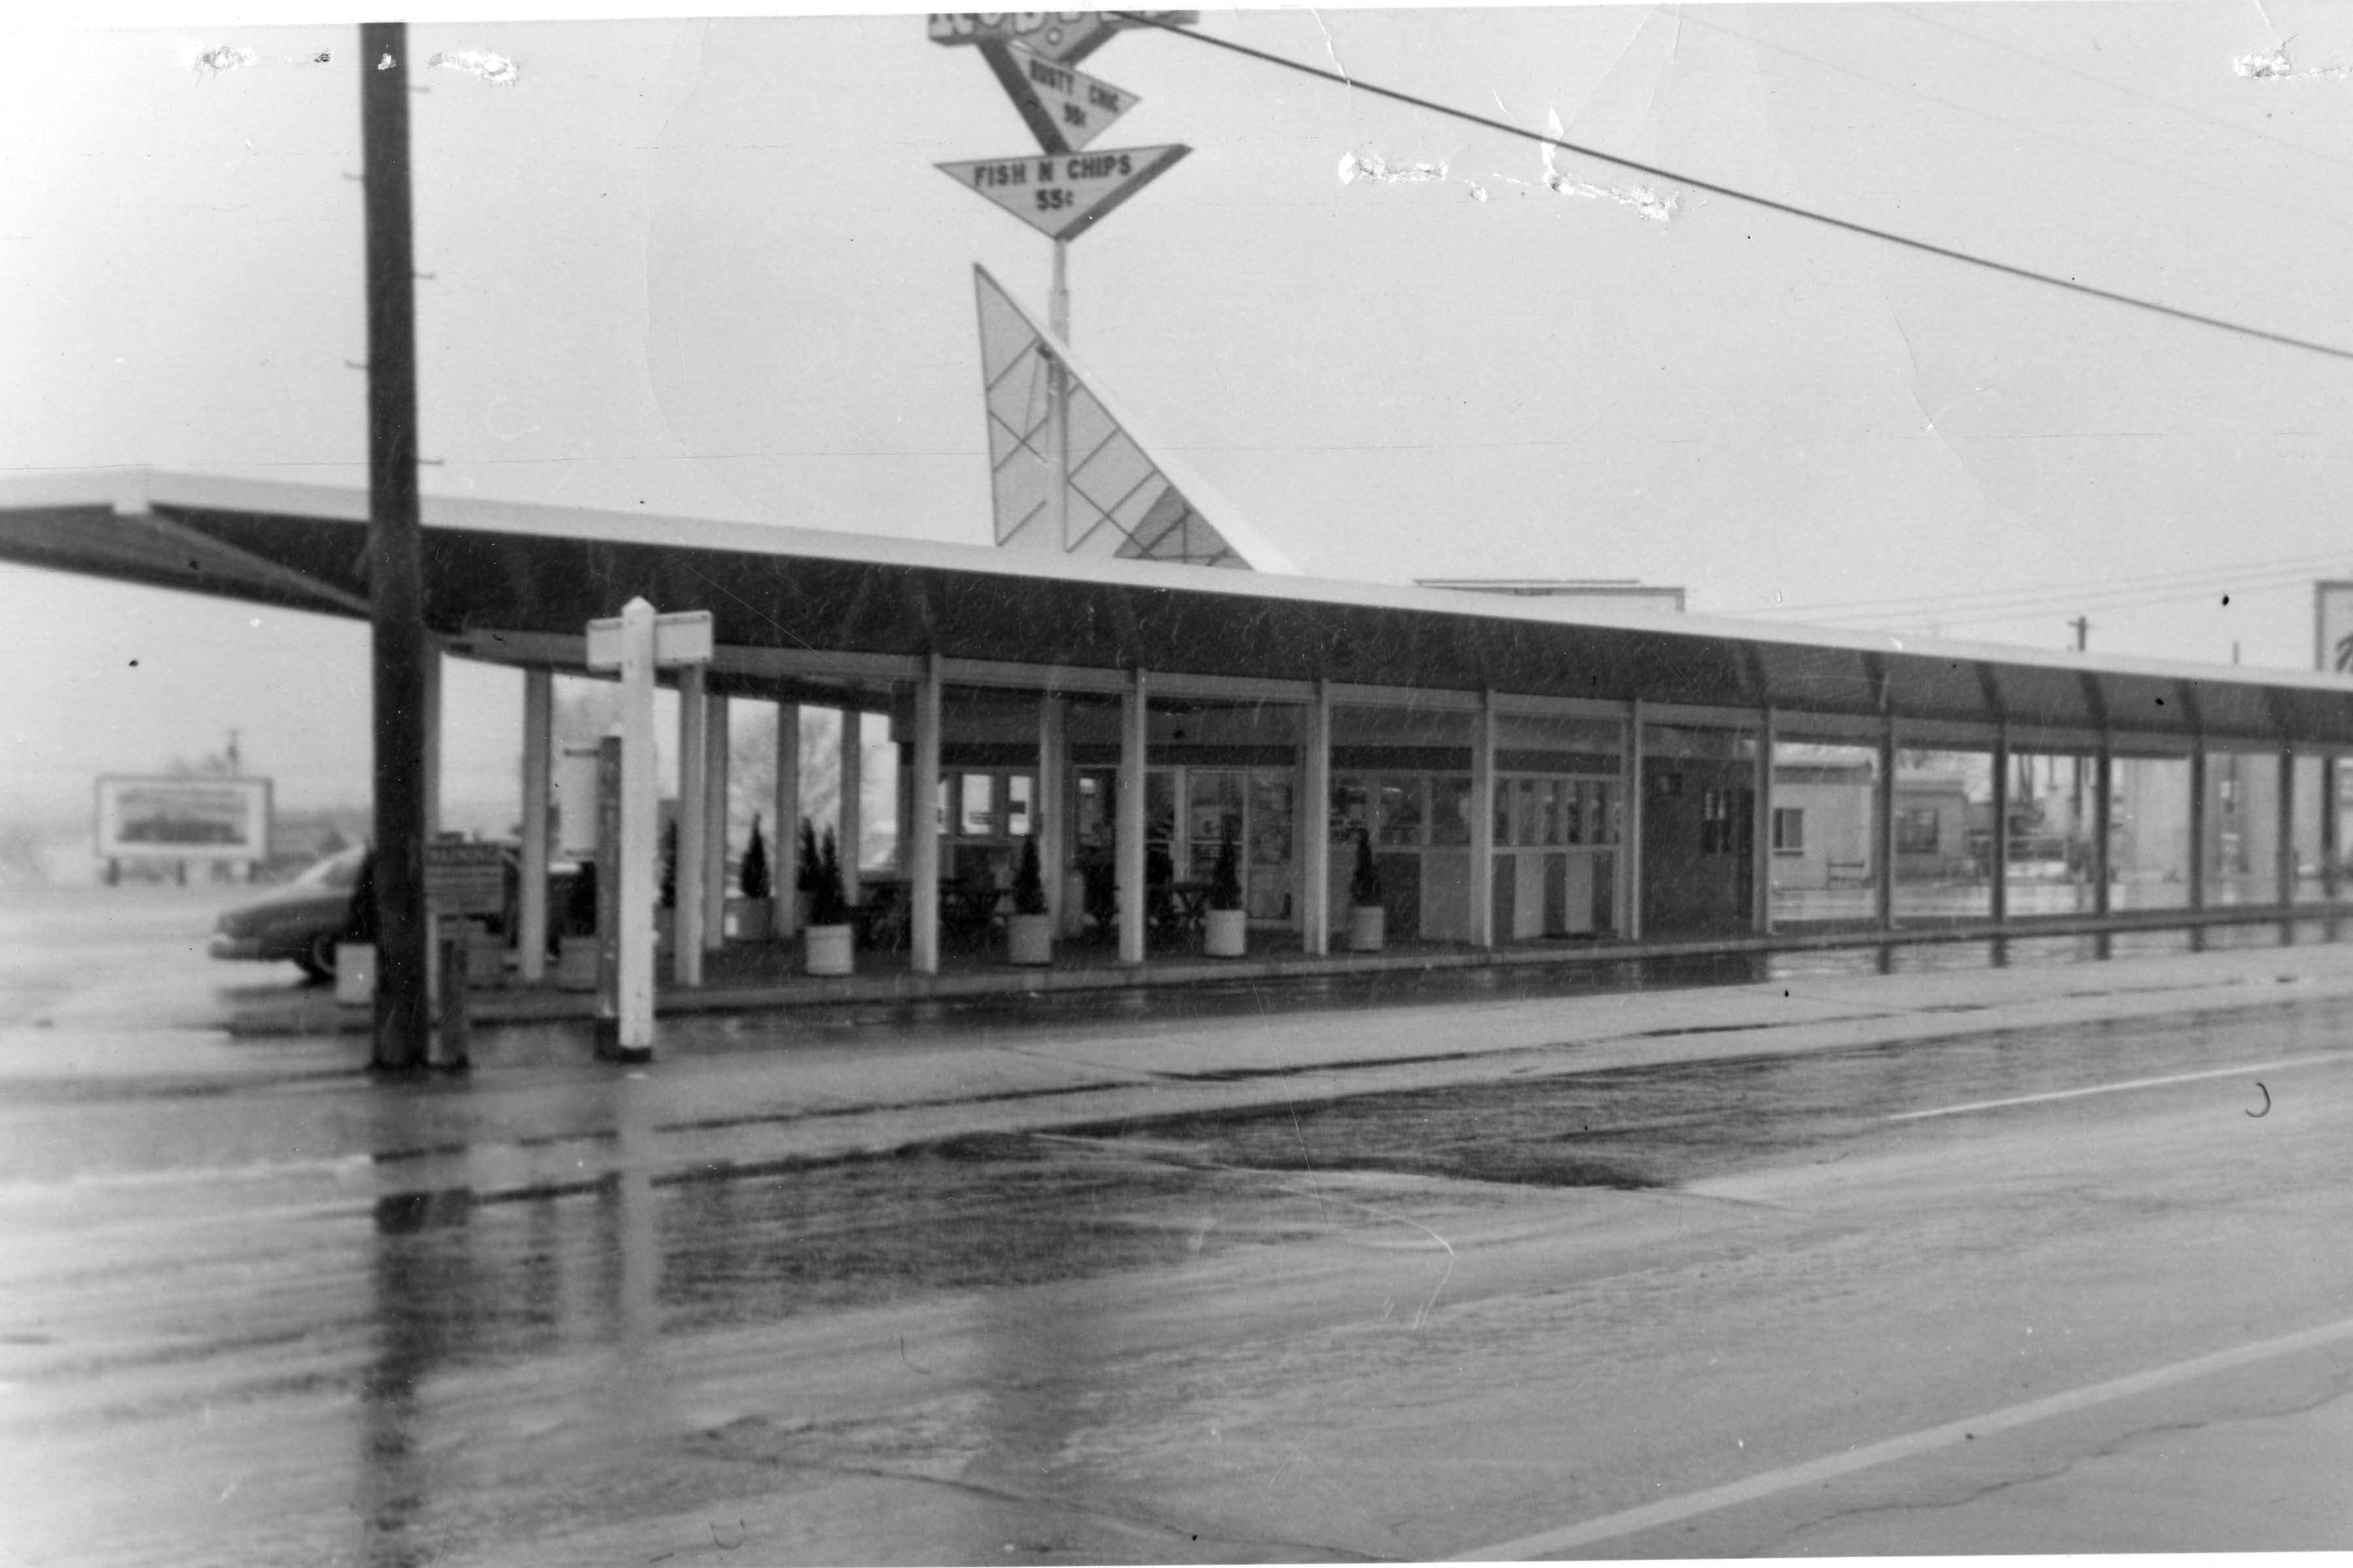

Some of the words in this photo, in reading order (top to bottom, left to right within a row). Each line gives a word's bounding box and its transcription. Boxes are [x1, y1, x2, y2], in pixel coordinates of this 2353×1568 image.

[974, 163, 1027, 186] FISH
[1037, 159, 1054, 182] N
[1067, 154, 1132, 180] CHIPS
